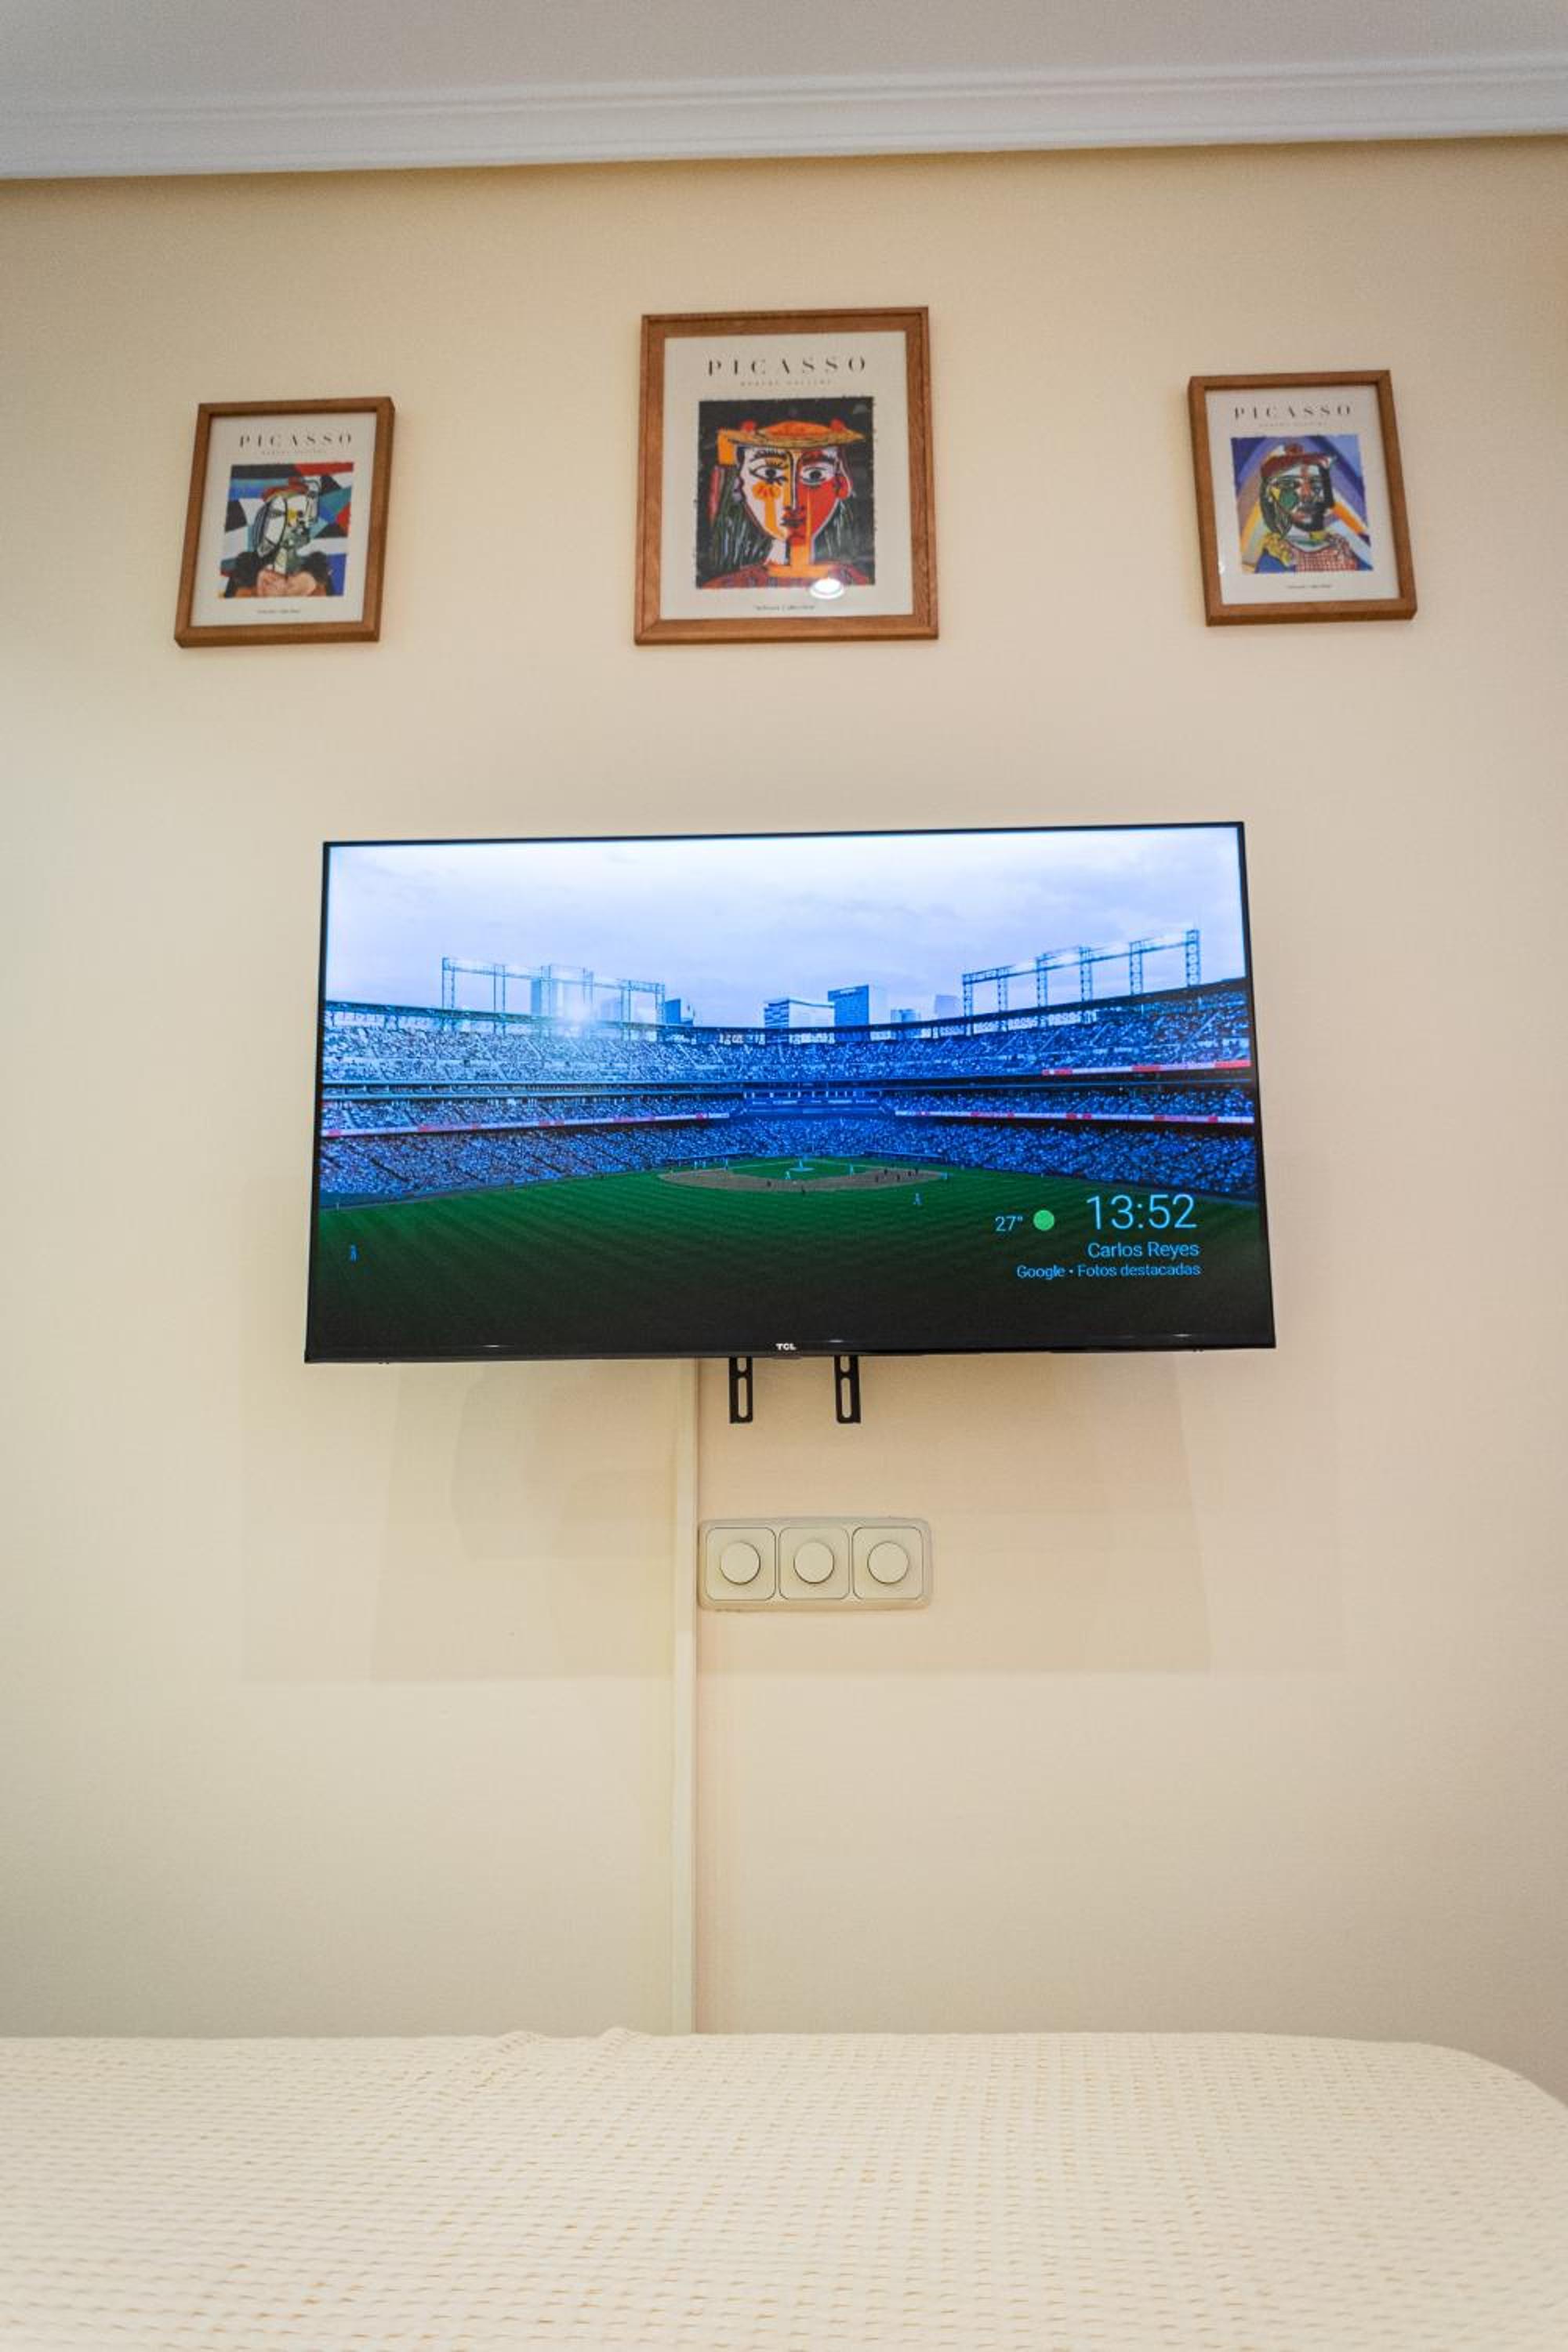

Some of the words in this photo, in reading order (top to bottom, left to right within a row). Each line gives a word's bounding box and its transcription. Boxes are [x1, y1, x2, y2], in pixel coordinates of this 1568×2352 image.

[708, 358, 866, 376] PICASSO
[1235, 405, 1351, 419] PICASSO
[239, 434, 352, 448] PICASSO
[1086, 1193, 1198, 1230] 13:52
[1087, 1242, 1142, 1258] Carlos
[1147, 1241, 1200, 1260] Reyes
[1016, 1264, 1065, 1280] Google
[1078, 1263, 1117, 1277] Fotos
[1120, 1261, 1201, 1276] destacadas
[775, 1342, 797, 1351] TCL
